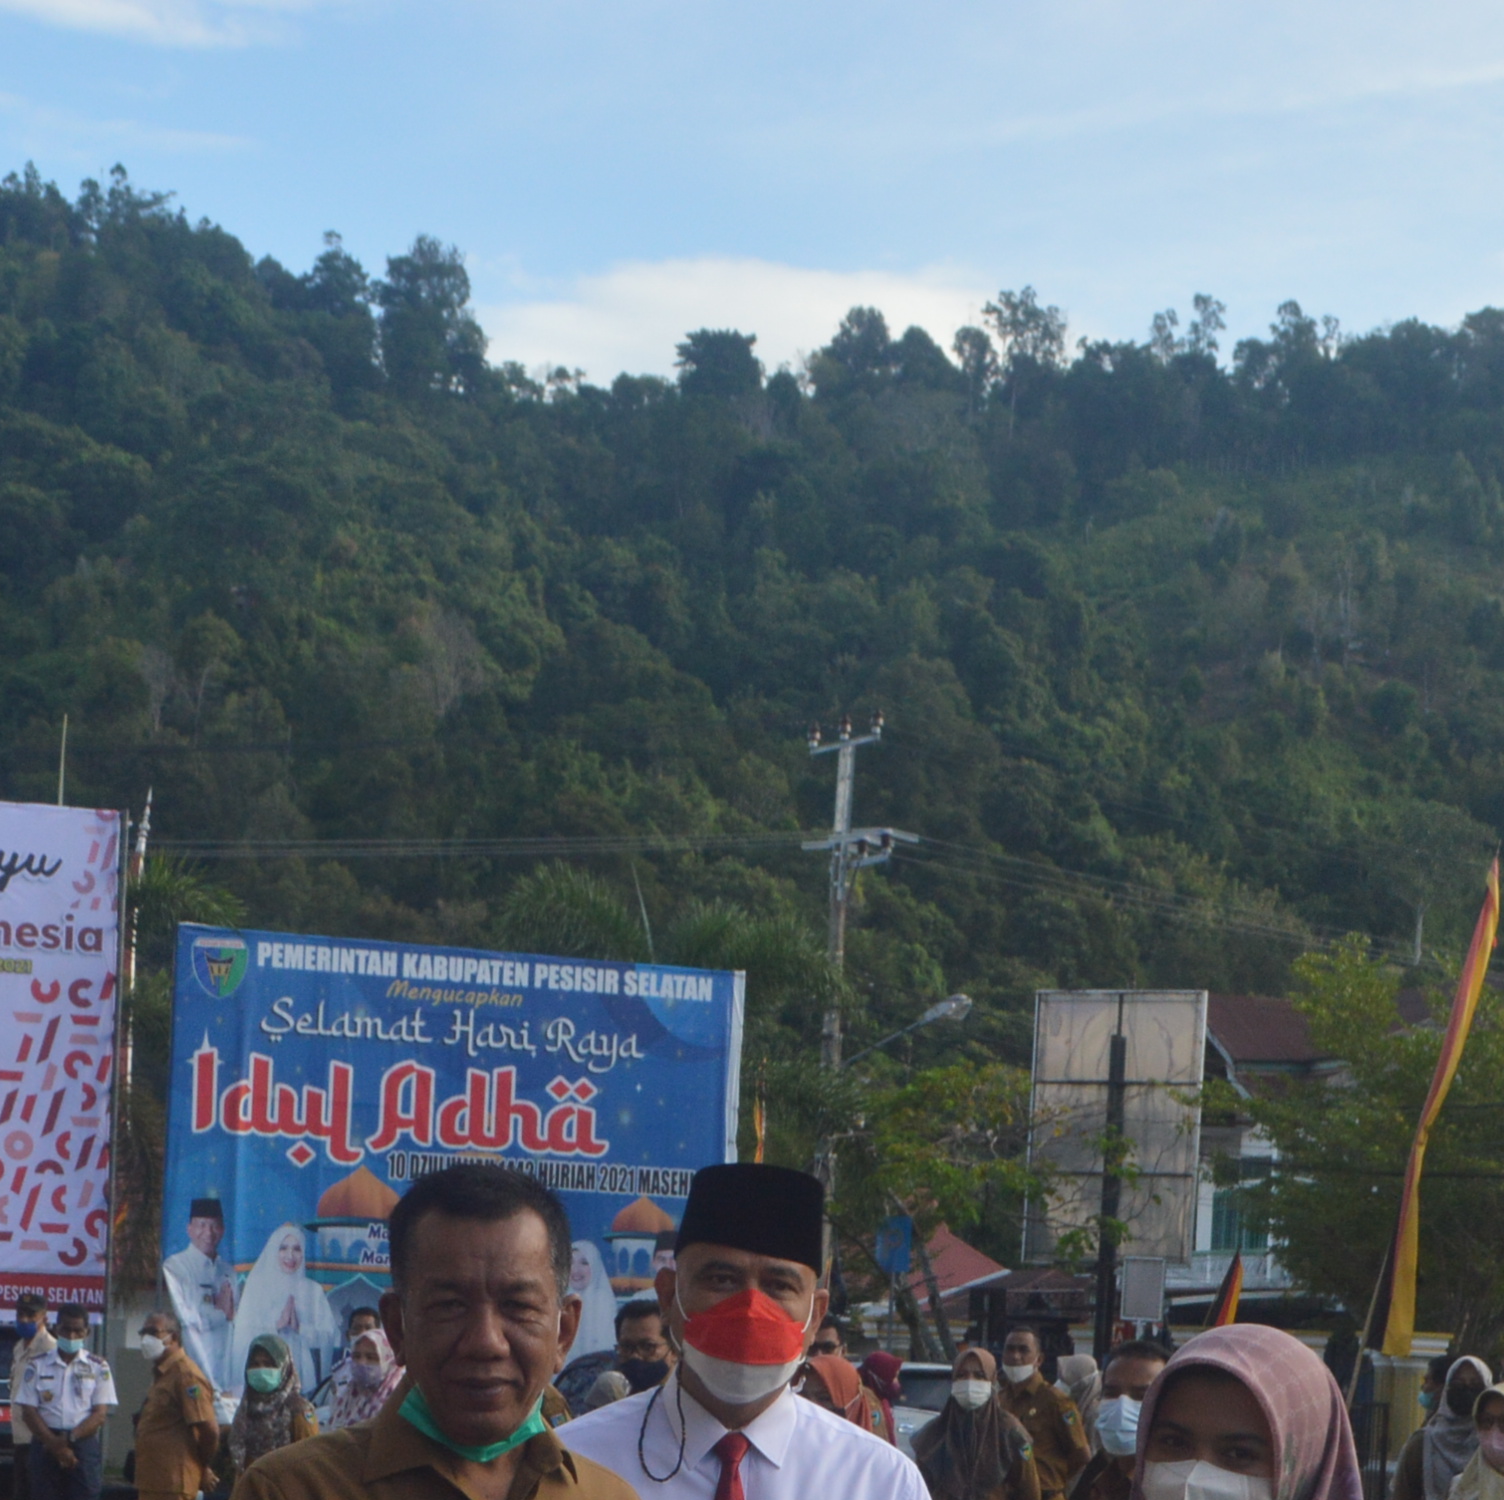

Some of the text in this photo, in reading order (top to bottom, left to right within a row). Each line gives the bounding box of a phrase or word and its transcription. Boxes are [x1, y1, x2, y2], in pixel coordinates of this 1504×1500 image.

[257, 942, 713, 1001] PEMERINTAH KABUPATEN PESISIR SELATAN
[387, 980, 523, 1008] Mengucapkan
[260, 997, 643, 1072] Selamat Hari Raya
[192, 1047, 364, 1166] Idul
[388, 1152, 406, 1179] 10
[539, 1161, 595, 1190] HIJRIAH
[599, 1165, 635, 1193] 2021
[48, 1287, 105, 1305] SELATAN
